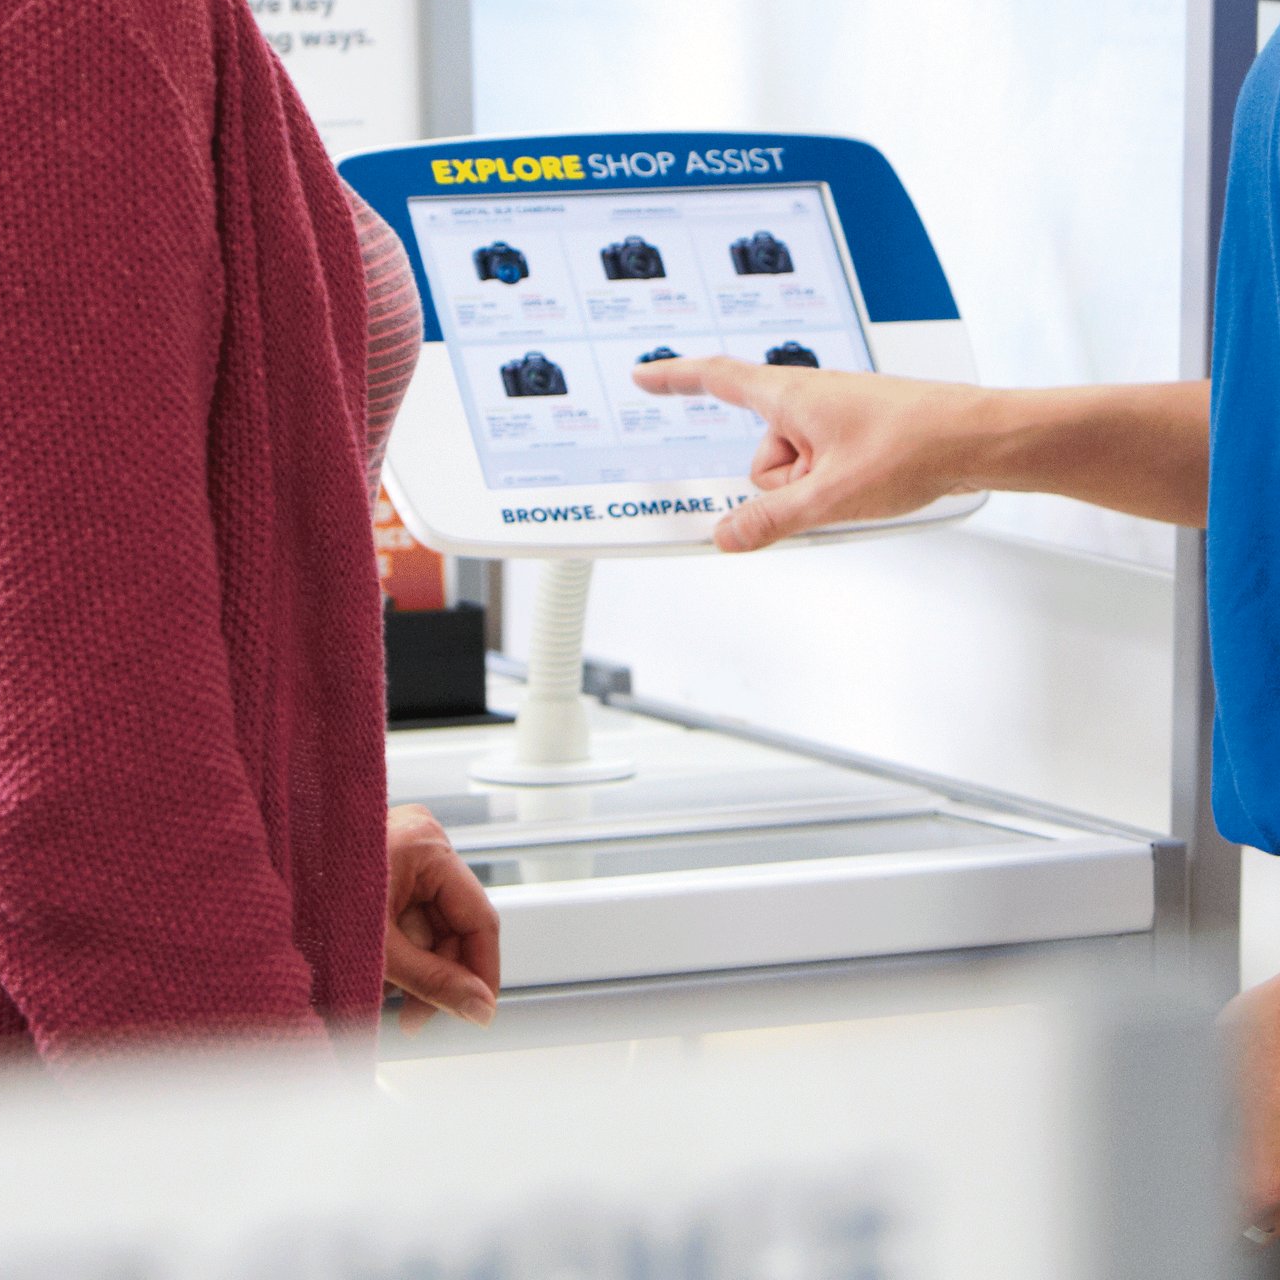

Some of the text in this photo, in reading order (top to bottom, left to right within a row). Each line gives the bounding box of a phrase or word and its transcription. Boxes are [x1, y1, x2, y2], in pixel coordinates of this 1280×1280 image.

[431, 147, 786, 185] EXPLORE SHOP ASSIST
[502, 504, 604, 524] BROWSE.
[608, 496, 723, 519] COMPARE.
